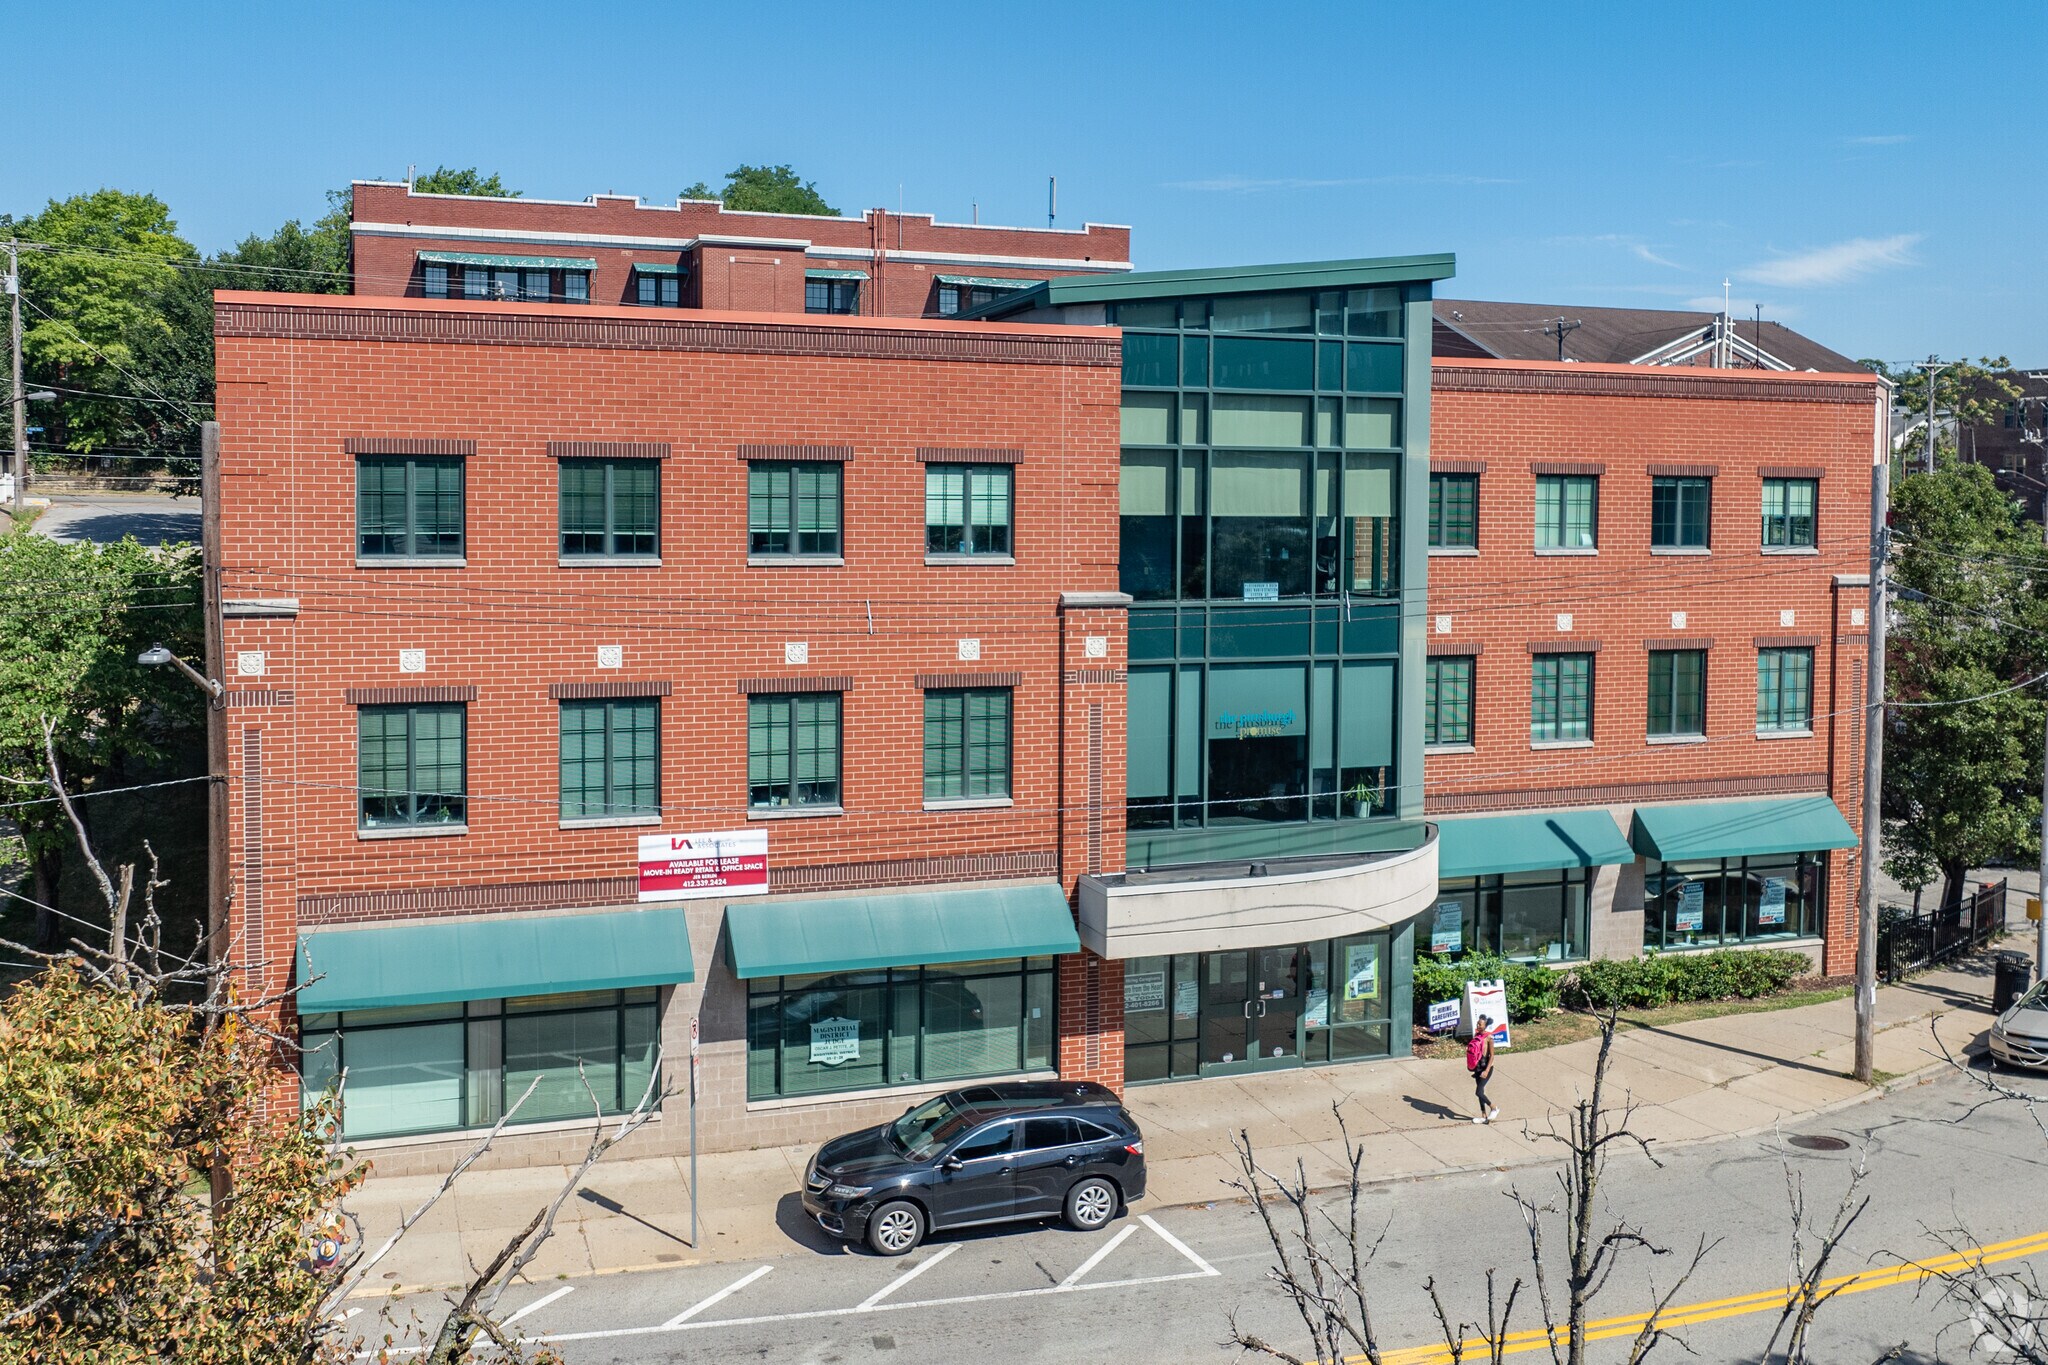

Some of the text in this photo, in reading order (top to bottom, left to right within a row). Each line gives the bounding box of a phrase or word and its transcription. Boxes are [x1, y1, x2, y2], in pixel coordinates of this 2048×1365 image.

[1240, 708, 1296, 726] pittsburgh
[669, 860, 704, 868] AVAILABLE
[683, 879, 727, 887] 412.339.2424
[1437, 1005, 1452, 1013] HIRING
[1432, 1010, 1458, 1021] CAREGIVERS
[814, 1025, 856, 1033] MAGISTERIAL
